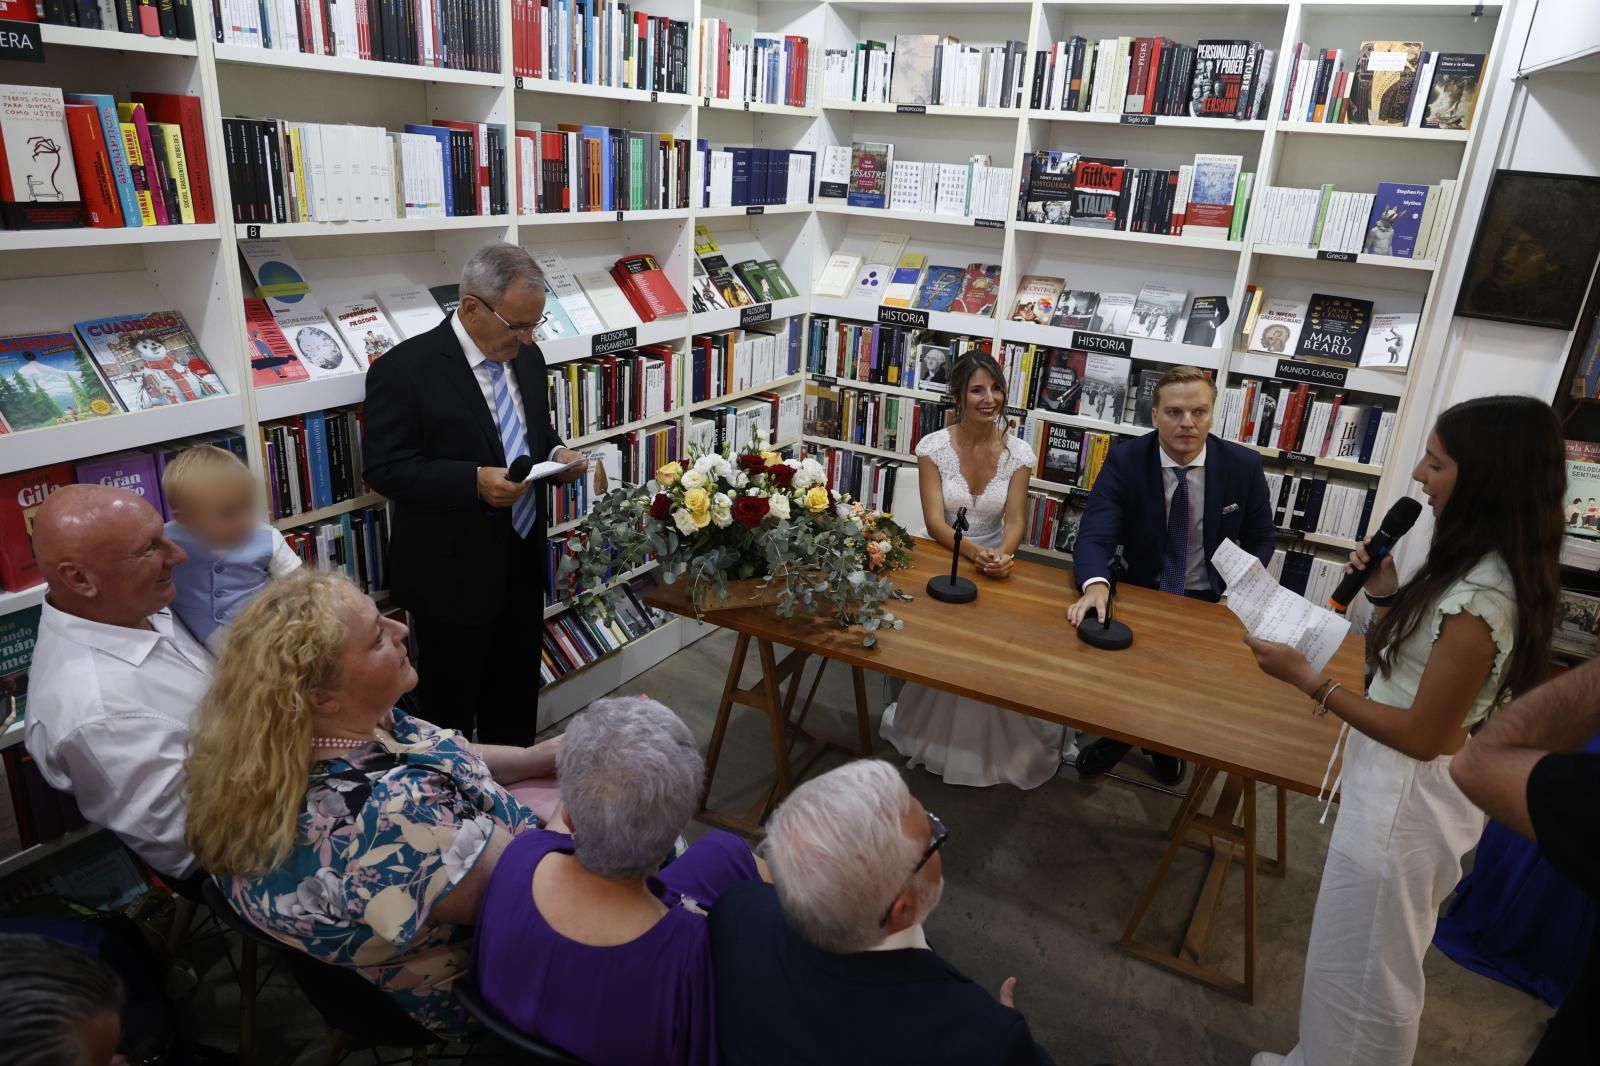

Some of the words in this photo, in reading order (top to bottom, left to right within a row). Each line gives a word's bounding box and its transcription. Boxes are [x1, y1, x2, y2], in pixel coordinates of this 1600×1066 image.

[1138, 42, 1148, 66] FIGES
[1197, 44, 1247, 60] PERSONALIDAD
[1216, 60, 1221, 74] Y
[1221, 60, 1244, 74] PODER
[1241, 48, 1255, 91] OCTUBRE
[516, 78, 522, 87] G
[1226, 84, 1240, 98] IAN
[32, 96, 60, 104] IDIOTAS
[1202, 97, 1237, 113] KERSHAW
[1128, 116, 1141, 124] Siglo
[850, 168, 887, 180] DESASTRE
[1076, 194, 1113, 214] STALIN
[250, 226, 257, 237] B
[1326, 252, 1348, 260] Grecia
[339, 306, 378, 320] SUPERHÉROES
[742, 312, 770, 324] PENSAMIENTO
[880, 310, 925, 325] HISTORIA
[1276, 310, 1297, 318] IMPERIO
[87, 314, 178, 337] CUADERNO
[600, 329, 628, 342] FILOSOFÍA
[1309, 331, 1352, 345] MARY
[595, 338, 634, 353] PENSAMIENTO
[1077, 335, 1126, 352] HISTORIA
[1303, 339, 1352, 355] BEARD
[1279, 365, 1310, 376] MUNDO
[1311, 368, 1344, 381] CLÁSICO
[1050, 427, 1067, 438] PAUL
[1341, 422, 1358, 440] lit
[1048, 437, 1081, 450] PRESTON
[1337, 440, 1356, 457] lat
[1286, 453, 1307, 462] Roma
[100, 472, 141, 487] Gran
